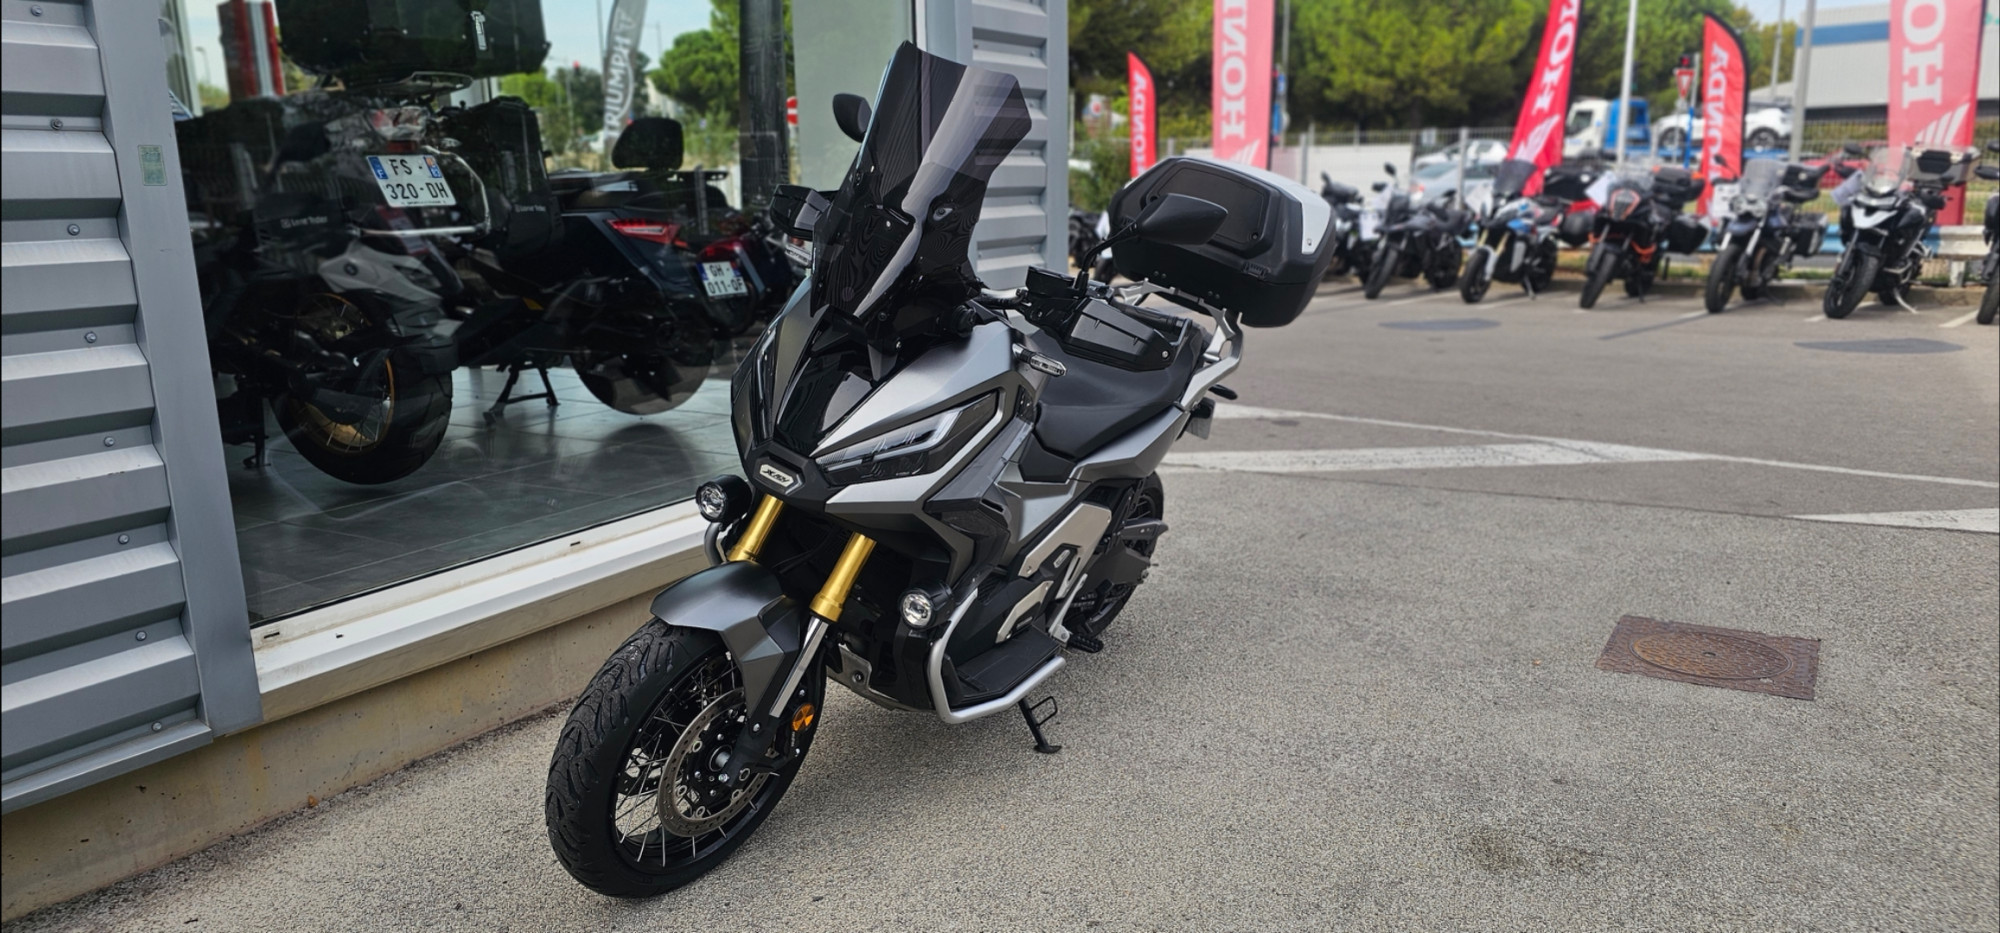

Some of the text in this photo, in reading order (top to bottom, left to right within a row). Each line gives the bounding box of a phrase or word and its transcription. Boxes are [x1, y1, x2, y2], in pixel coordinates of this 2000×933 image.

[603, 34, 634, 139] TRIUMPH
[1221, 0, 1247, 140] HON
[385, 183, 448, 200] 320-DH
